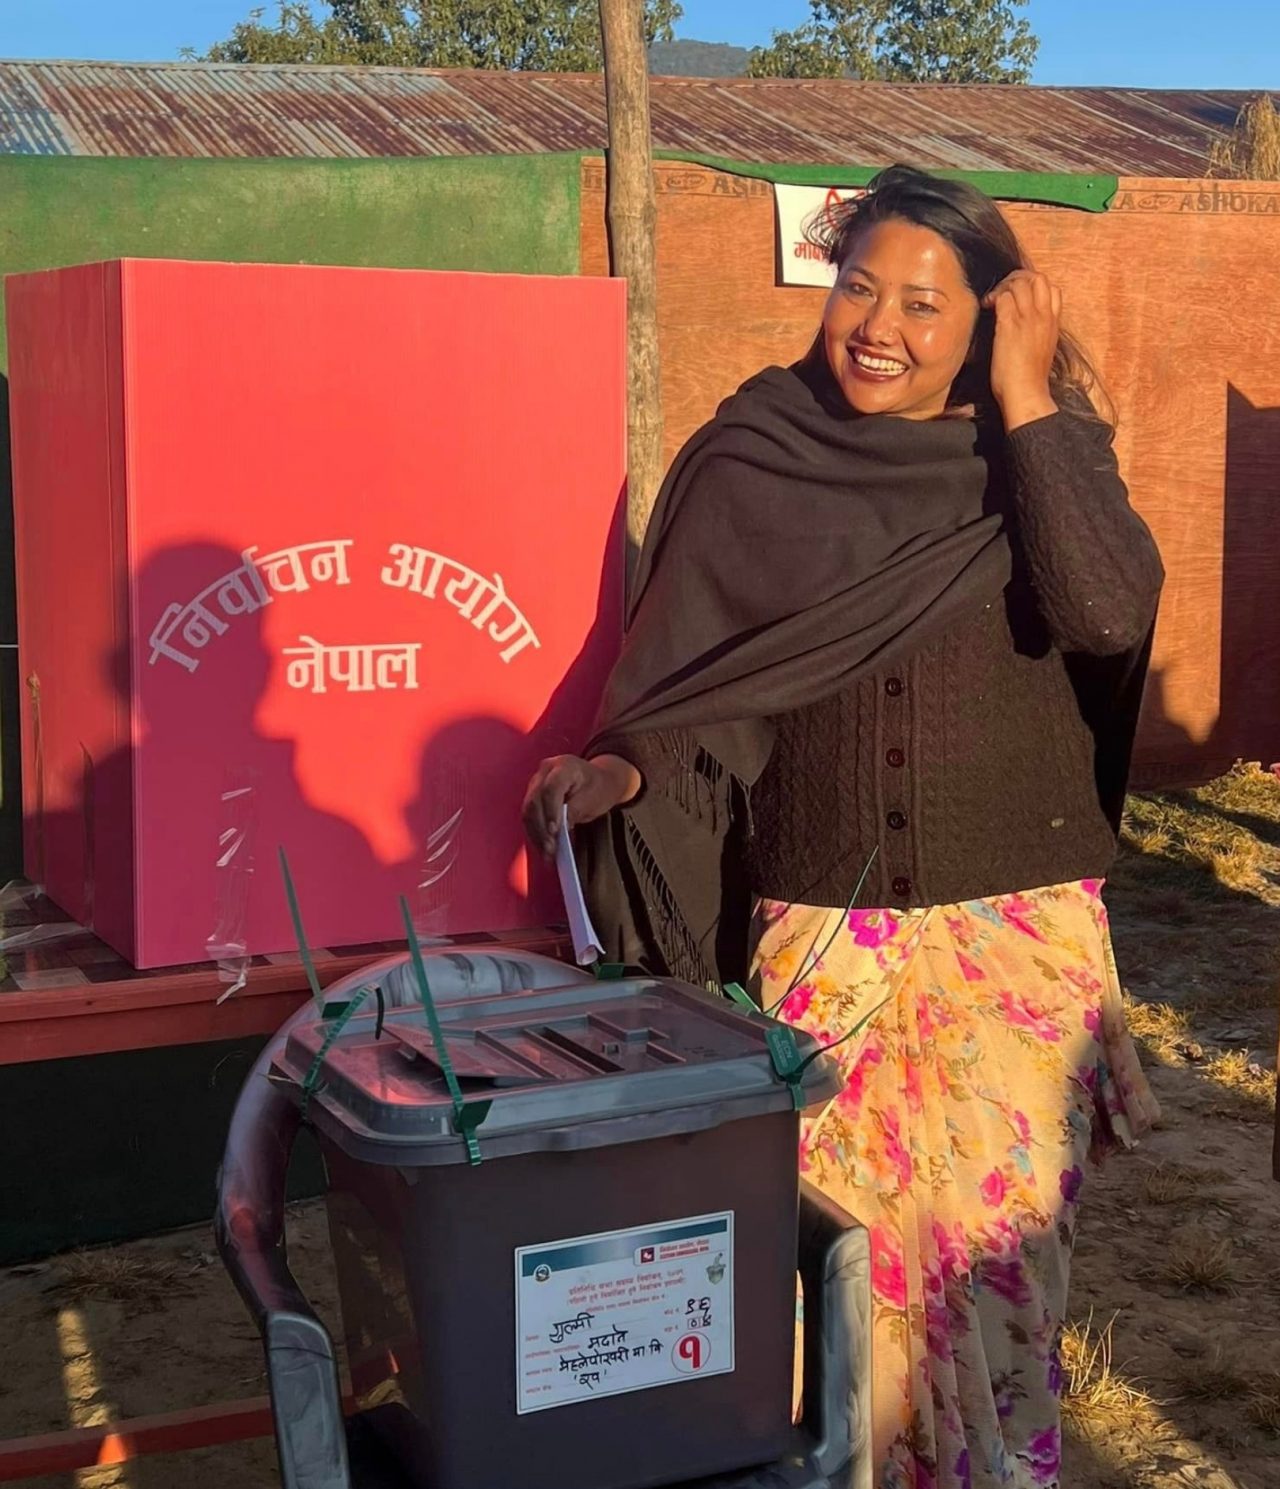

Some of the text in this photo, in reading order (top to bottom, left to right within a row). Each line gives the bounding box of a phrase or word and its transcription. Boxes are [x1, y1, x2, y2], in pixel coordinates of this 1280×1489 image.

[1179, 185, 1280, 213] ASHOKA
[148, 538, 542, 674] निर्वाचन आयोग
[281, 635, 423, 694] नेपाल
[550, 1312, 595, 1344] गुल्मी
[679, 1335, 700, 1369] १
